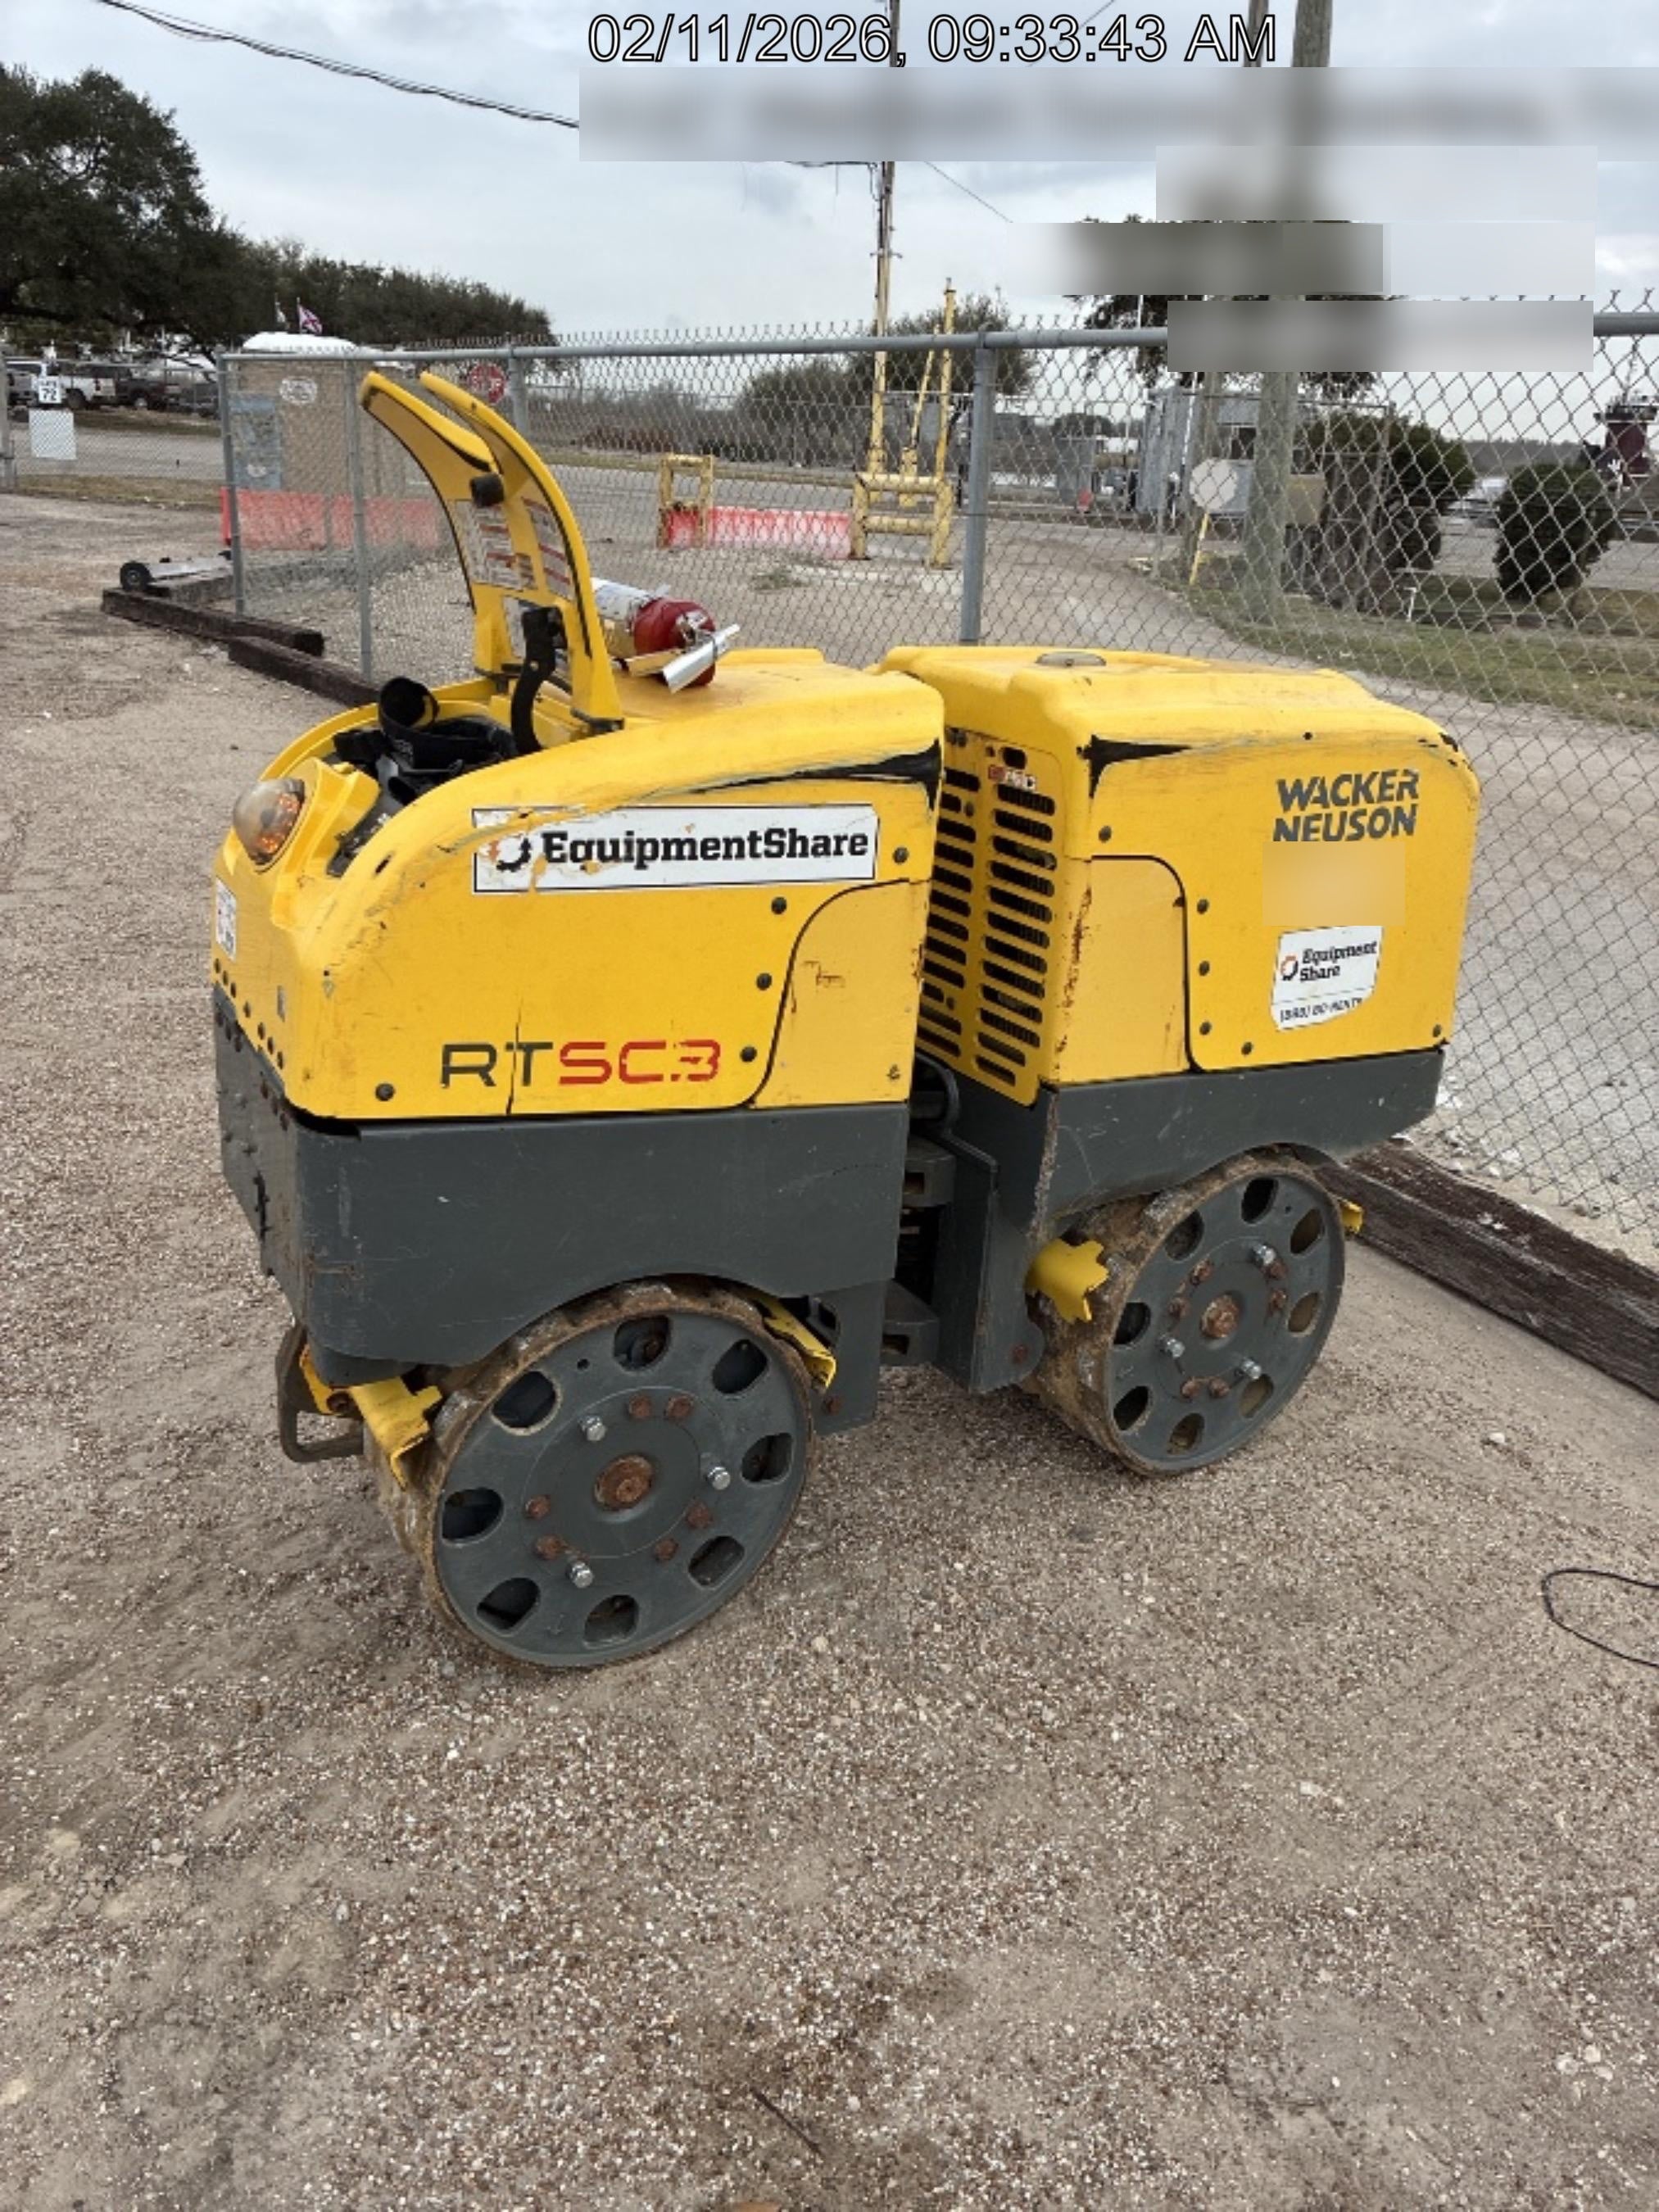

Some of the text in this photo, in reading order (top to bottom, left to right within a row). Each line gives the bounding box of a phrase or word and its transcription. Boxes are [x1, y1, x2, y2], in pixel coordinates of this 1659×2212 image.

[1276, 769, 1419, 812] WACKER
[1273, 804, 1416, 841] NEUSON
[542, 829, 869, 869] EquipmentShare
[1302, 941, 1377, 966] Equipment
[1300, 965, 1341, 981] Share
